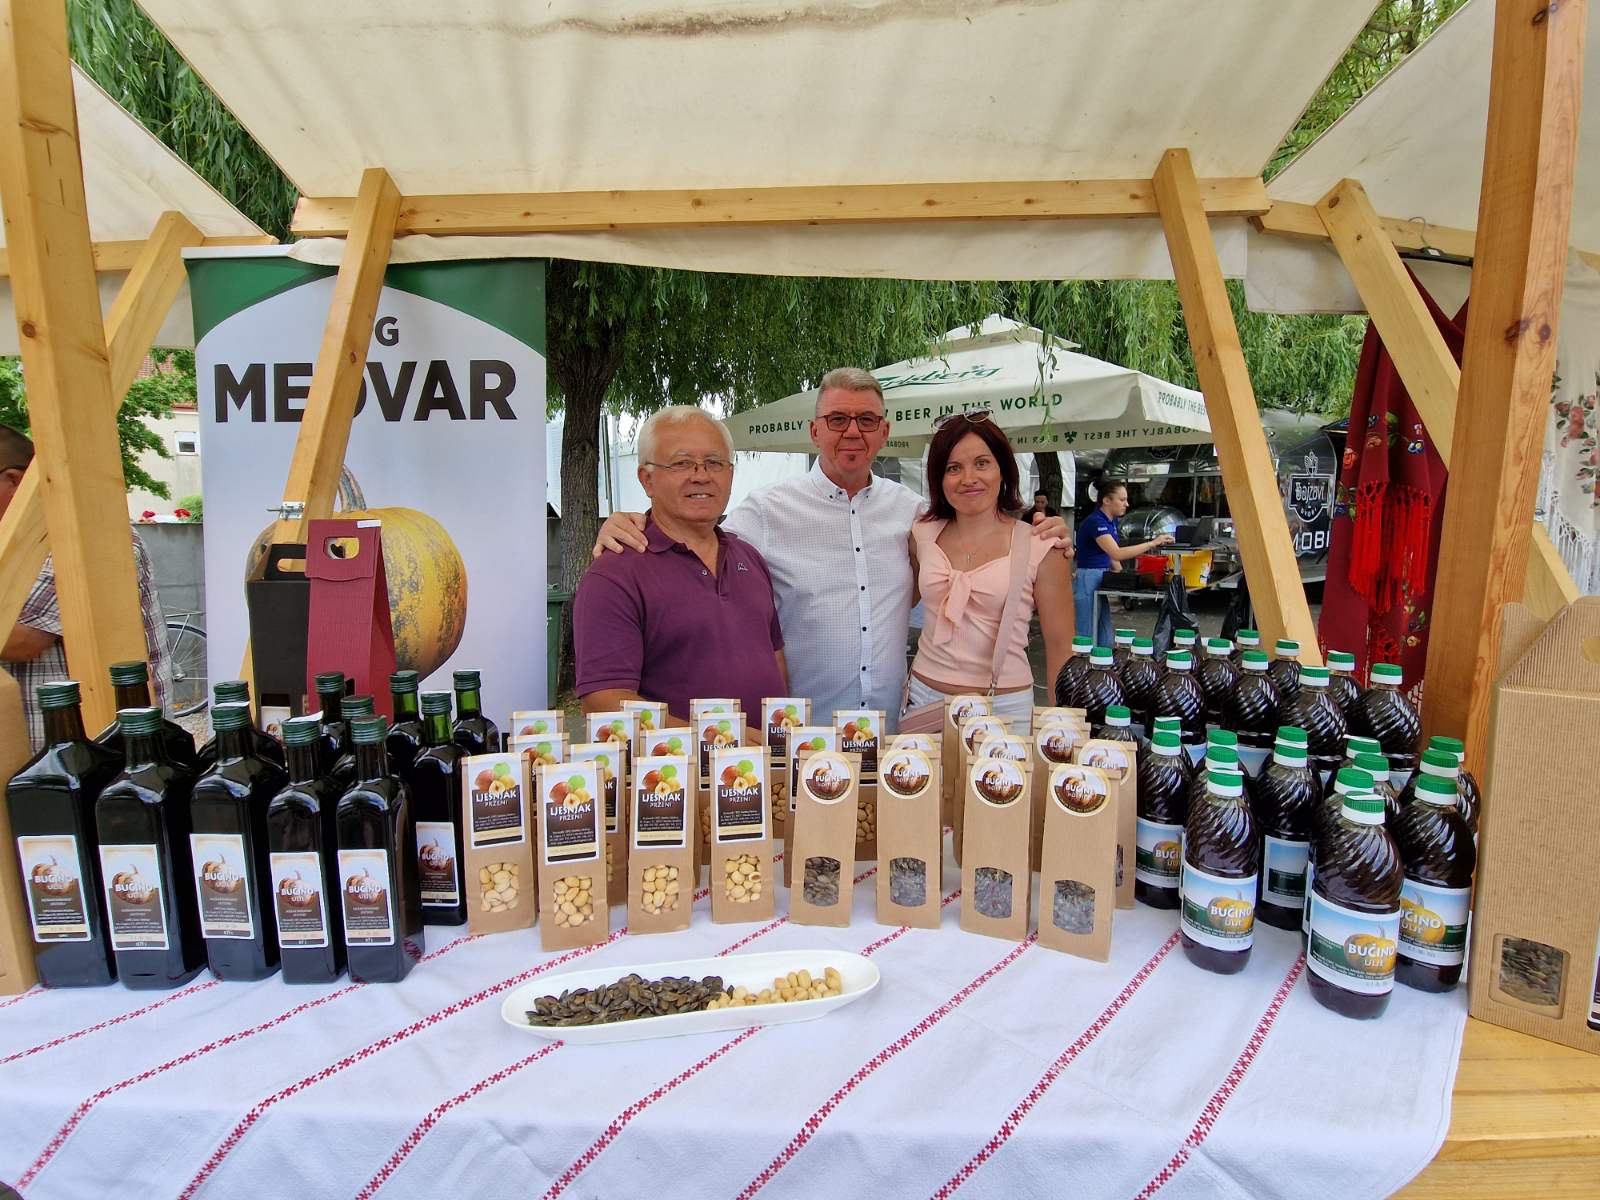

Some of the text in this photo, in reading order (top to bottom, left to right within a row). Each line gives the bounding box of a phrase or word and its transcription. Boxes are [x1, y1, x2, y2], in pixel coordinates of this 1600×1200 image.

[213, 360, 518, 423] MEVAR
[749, 420, 803, 434] PROBABLY
[895, 407, 931, 421] BEER
[939, 405, 954, 416] IN
[1000, 394, 1063, 411] WORLD
[1400, 908, 1441, 929] UČINO
